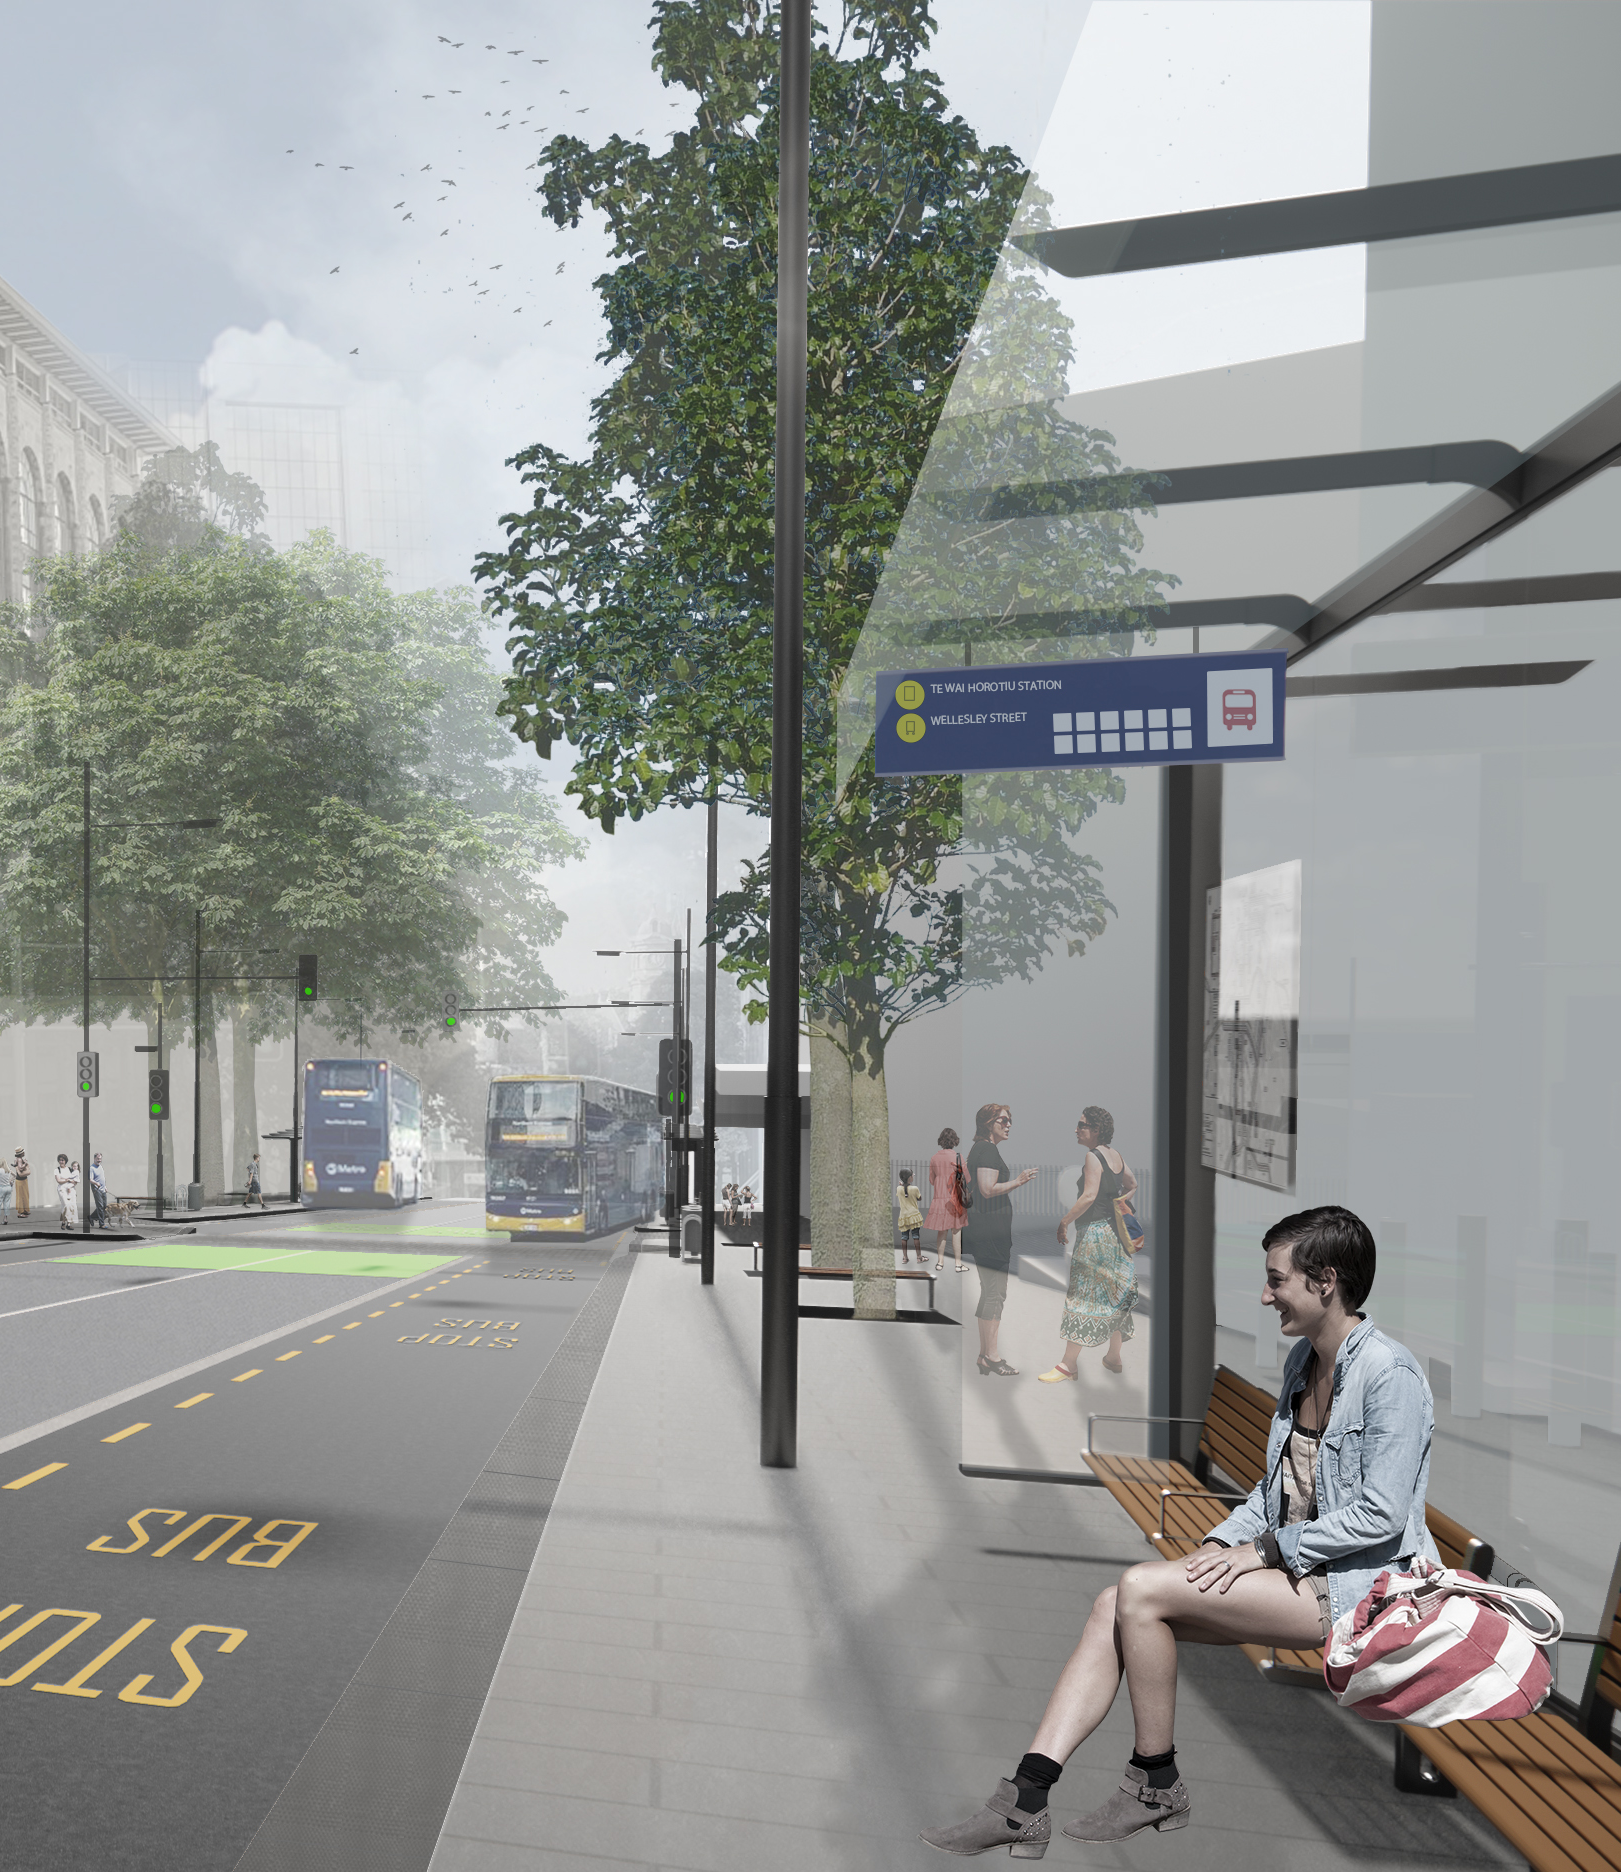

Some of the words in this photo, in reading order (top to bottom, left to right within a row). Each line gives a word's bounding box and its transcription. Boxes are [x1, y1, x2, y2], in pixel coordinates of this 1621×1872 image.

[930, 684, 943, 693] TE
[945, 683, 965, 693] WAI
[968, 681, 1016, 693] HOROTIU
[1018, 680, 1062, 691] STATION
[931, 713, 987, 725] WELLESLEY
[990, 712, 1027, 723] STREET
[338, 1163, 367, 1175] Metro
[434, 1318, 520, 1331] BUS
[397, 1333, 519, 1349] STOP
[86, 1508, 319, 1569] BUS
